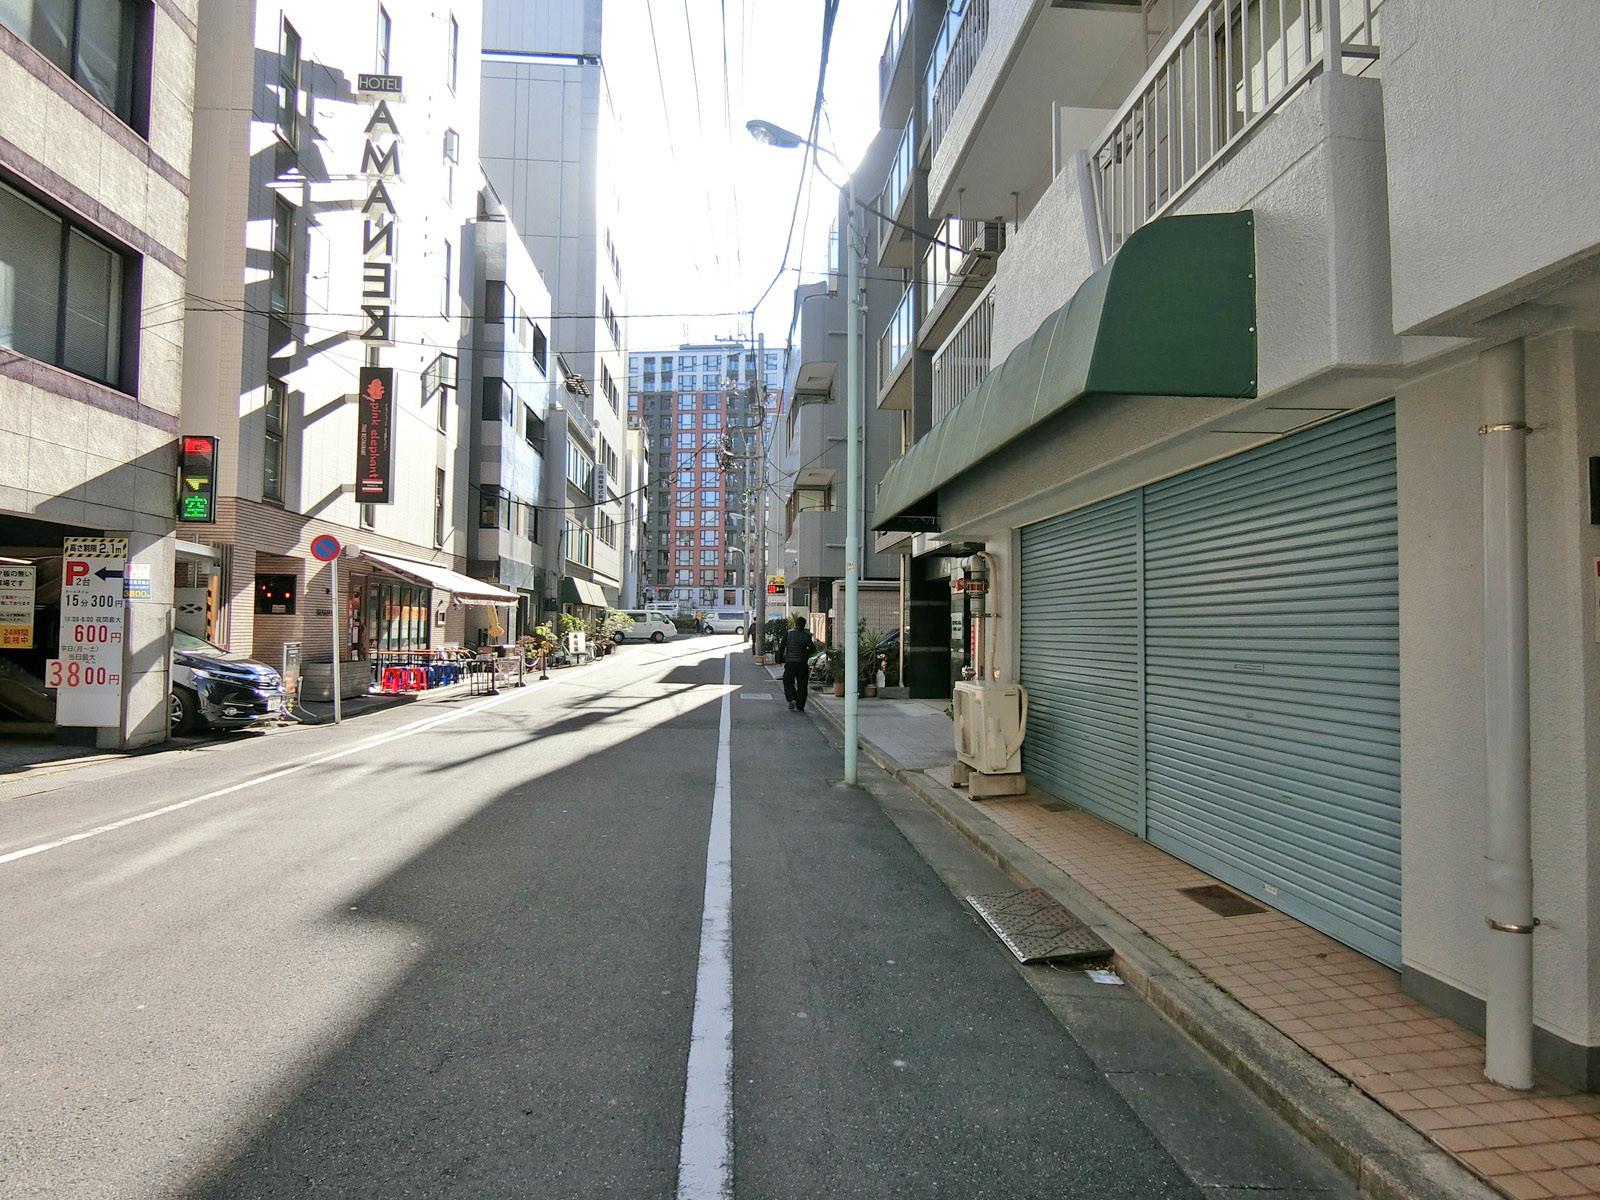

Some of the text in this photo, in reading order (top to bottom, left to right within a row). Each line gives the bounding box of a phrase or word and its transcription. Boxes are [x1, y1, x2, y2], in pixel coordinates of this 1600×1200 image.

[359, 76, 401, 91] HOTEL
[369, 402, 382, 426] pink
[368, 429, 381, 478] elephant
[184, 495, 208, 518] 空
[69, 543, 122, 554] 高さ制限 2.1m
[65, 561, 90, 586] P
[76, 577, 90, 587] 2台
[66, 594, 123, 608] 15分 300円
[3, 636, 29, 644] 監視中
[74, 624, 121, 643] 600円
[49, 661, 120, 687] 3800円
